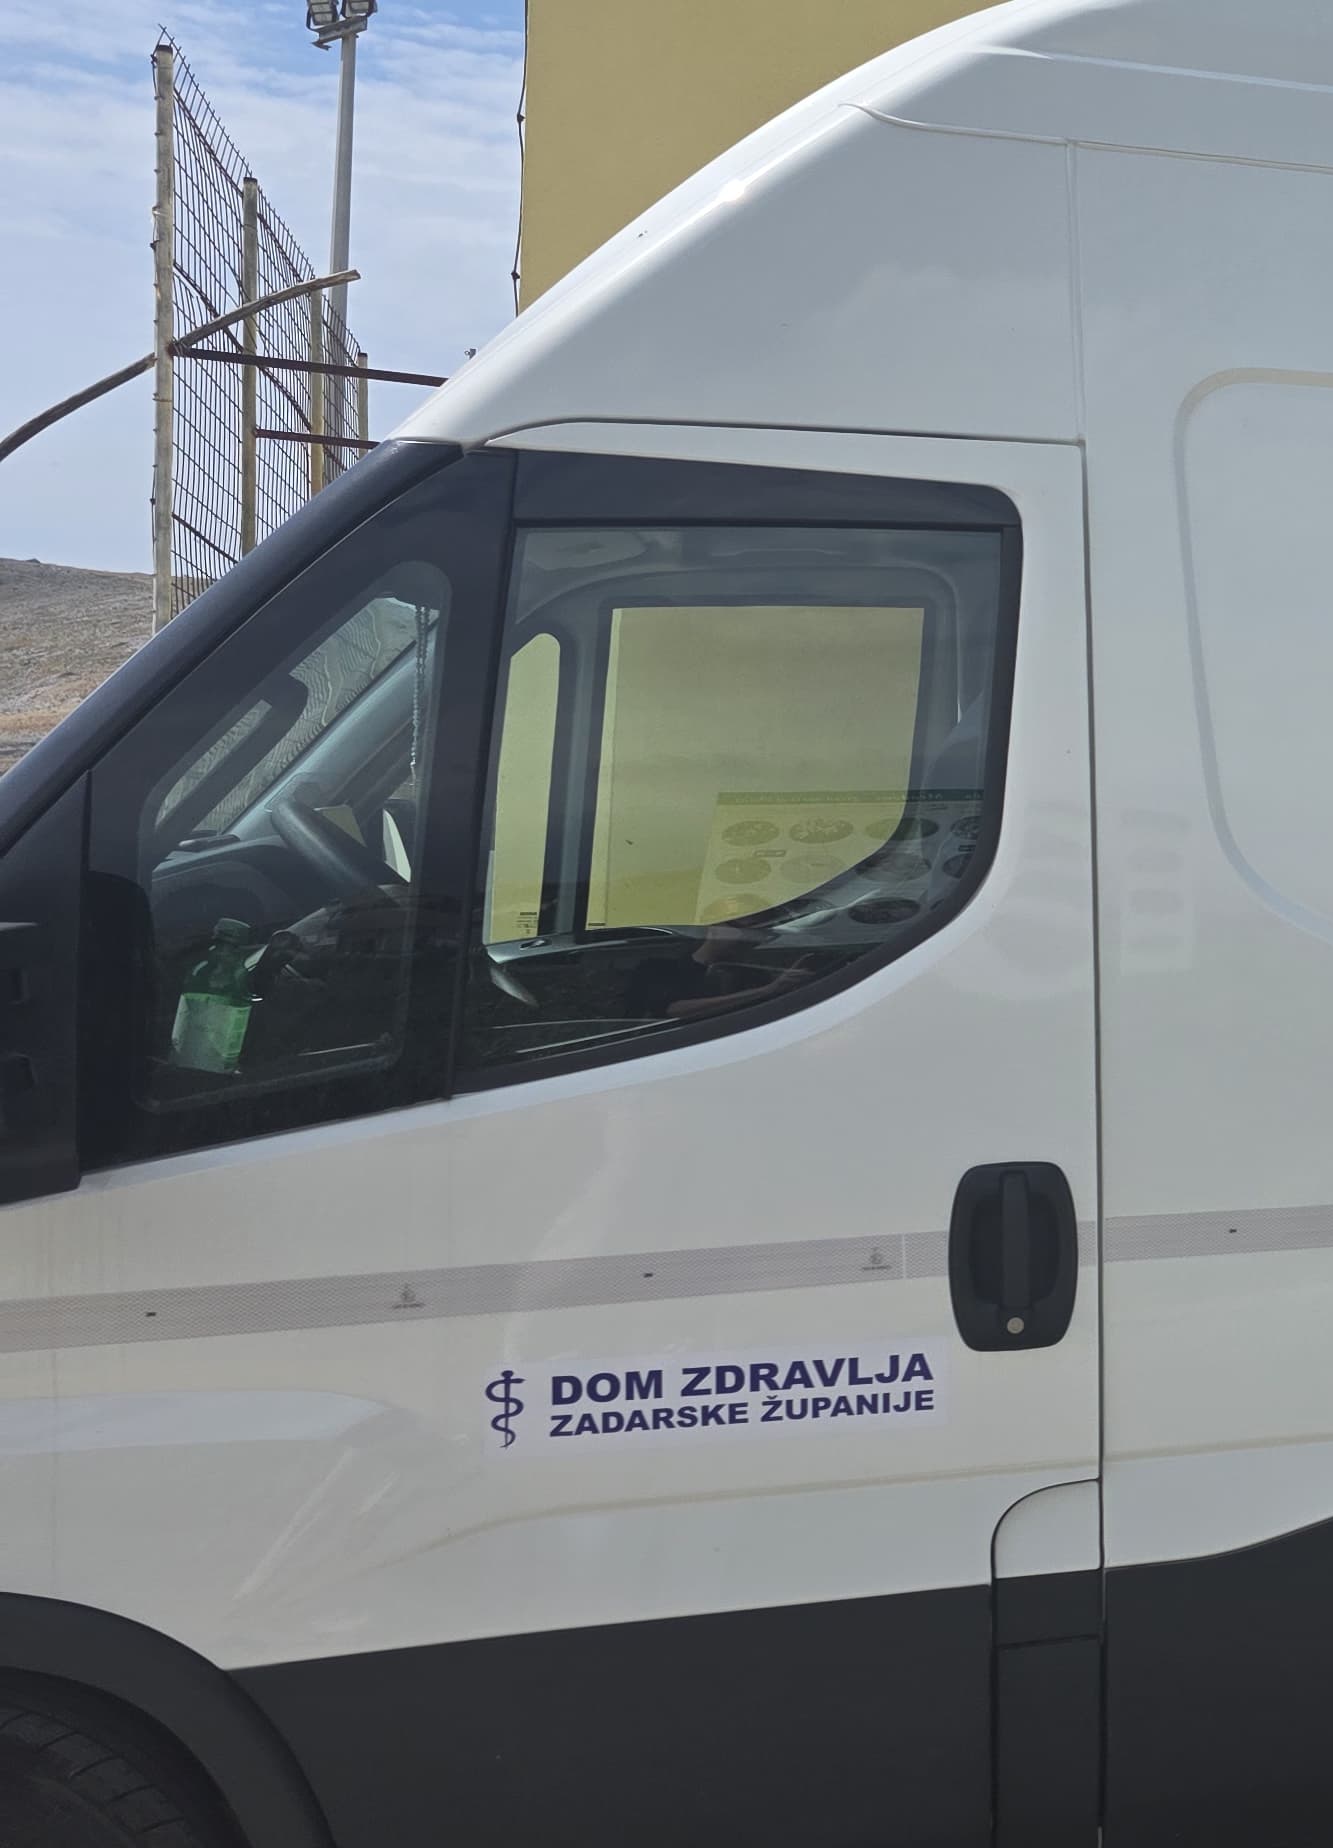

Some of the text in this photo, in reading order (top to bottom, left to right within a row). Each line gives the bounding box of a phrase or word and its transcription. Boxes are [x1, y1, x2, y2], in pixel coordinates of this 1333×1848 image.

[551, 1352, 934, 1406] DOM ZDRAVLJA
[549, 1389, 935, 1438] ZADARSKE ŽUPANIJE
